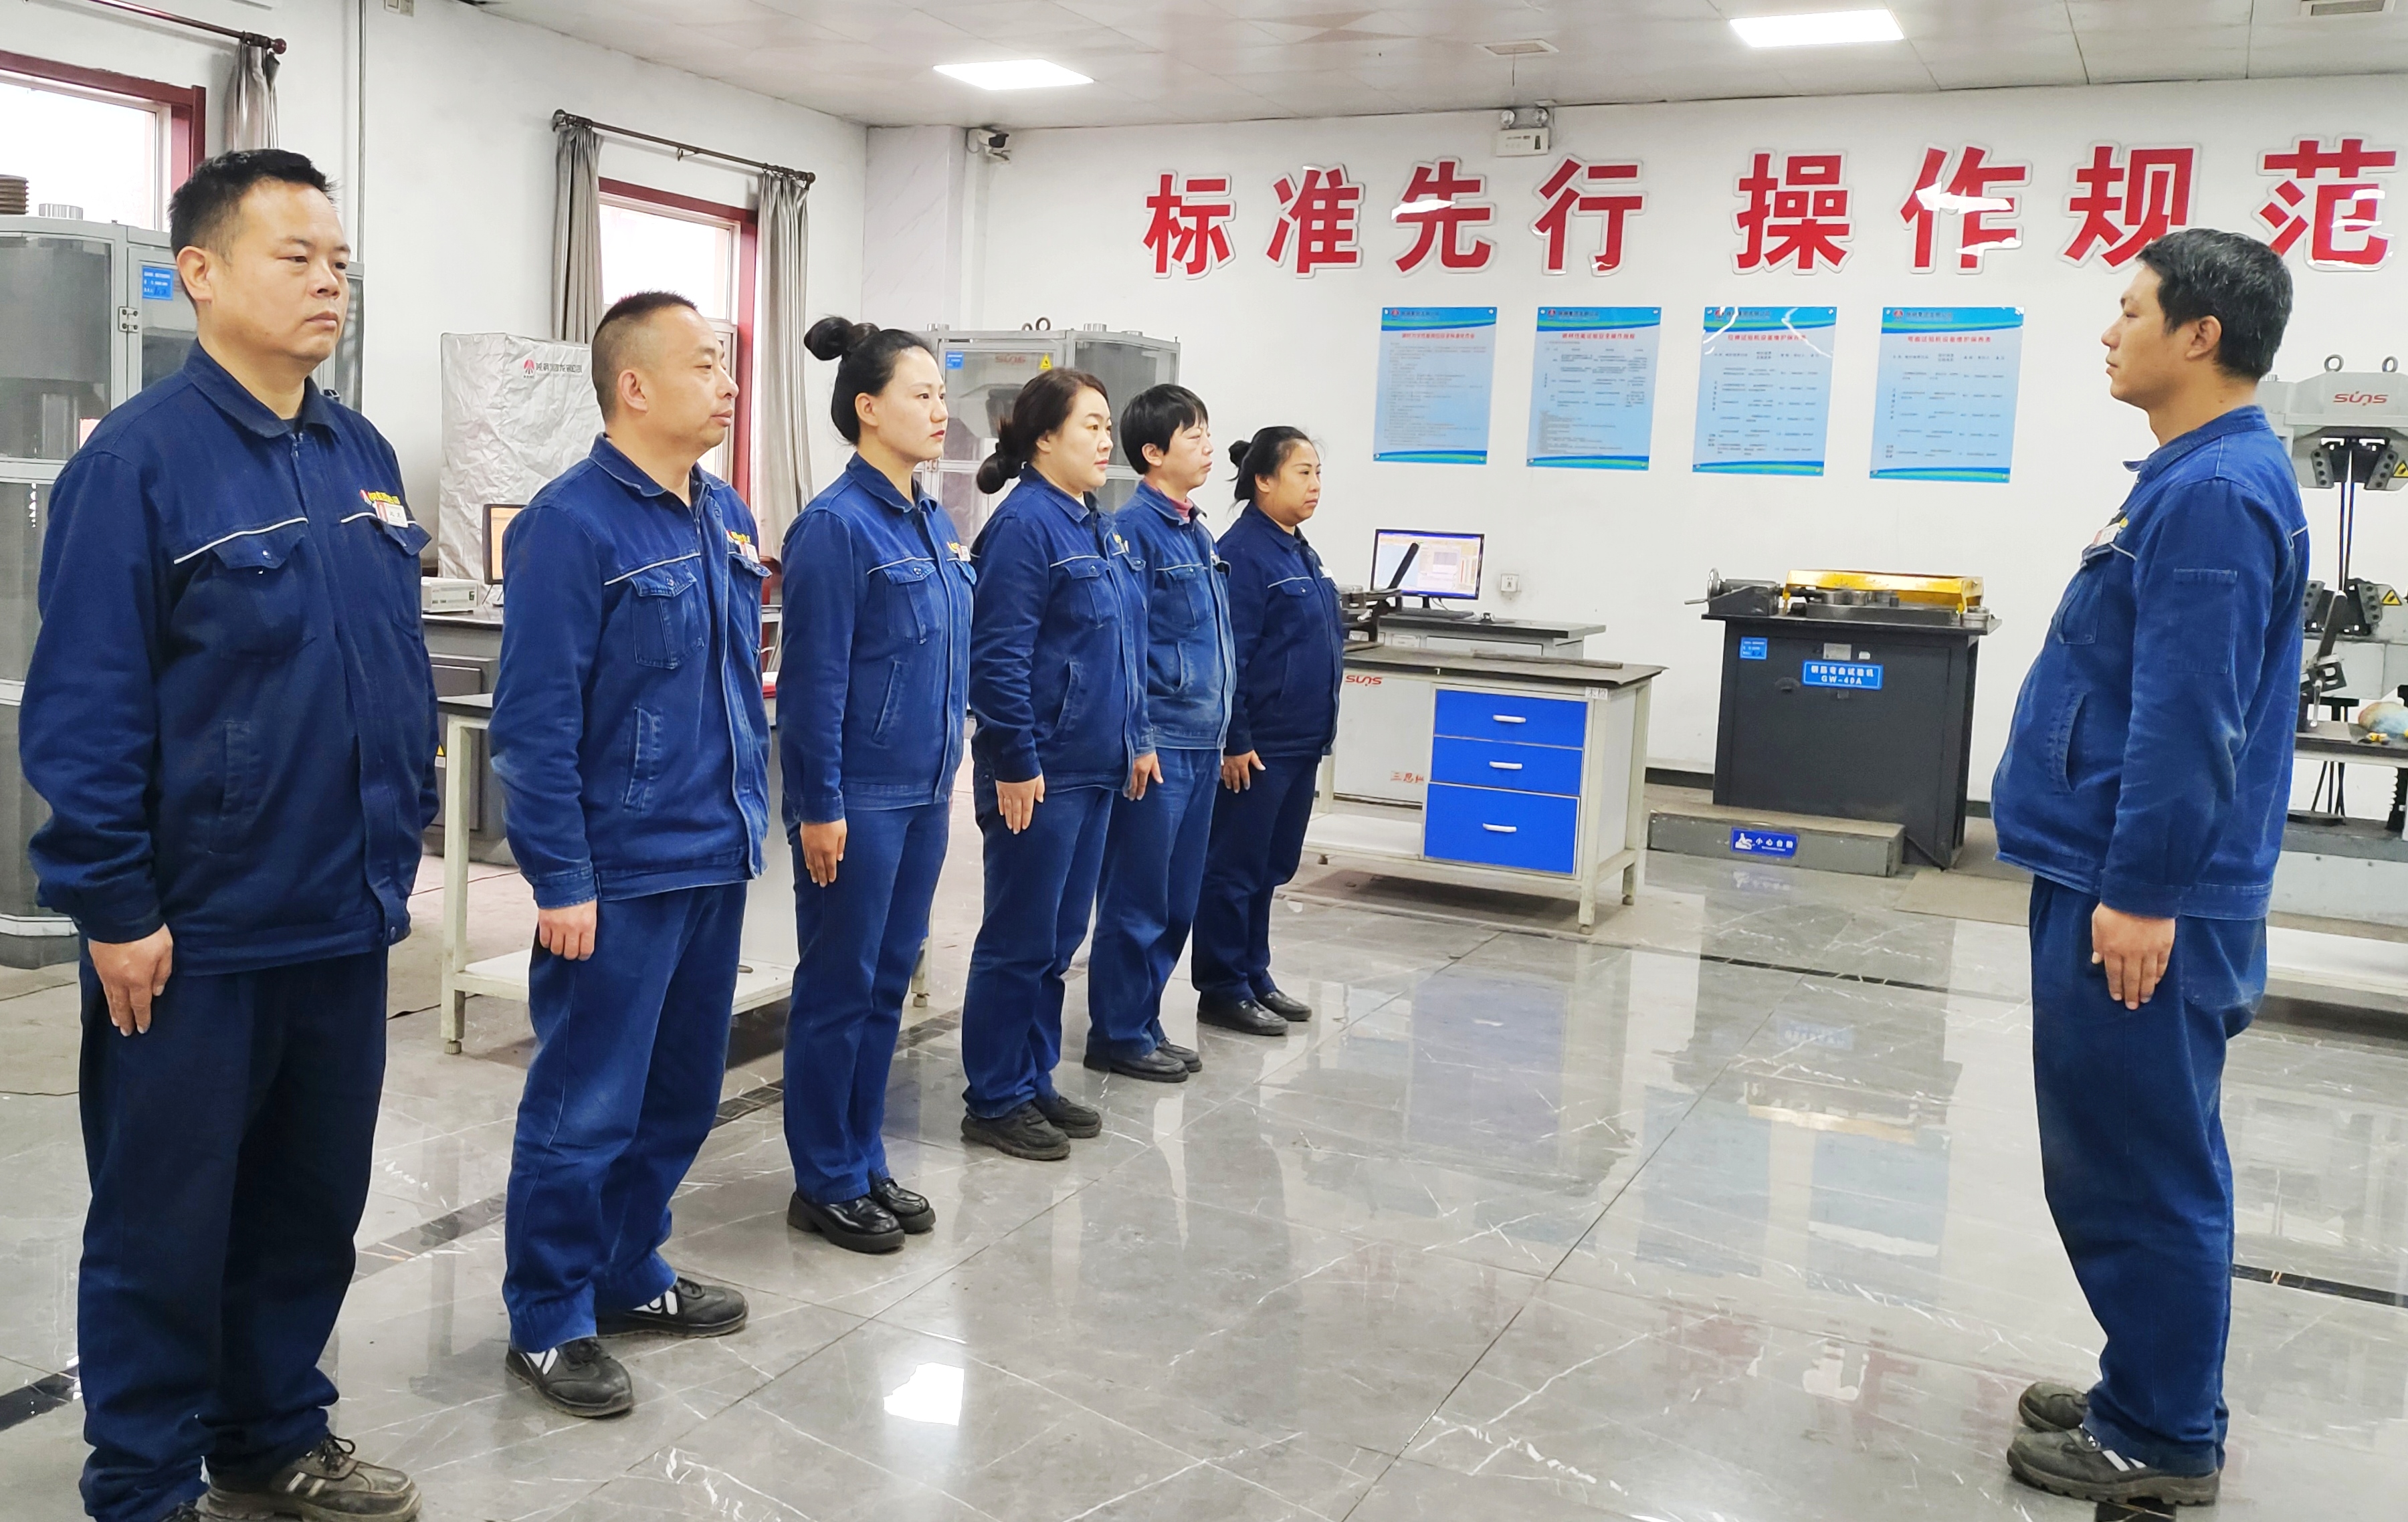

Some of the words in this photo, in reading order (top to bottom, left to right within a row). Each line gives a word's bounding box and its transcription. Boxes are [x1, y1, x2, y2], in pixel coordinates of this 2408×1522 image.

[1143, 158, 1643, 274] 标准先行
[1737, 139, 2397, 269] 操作规范
